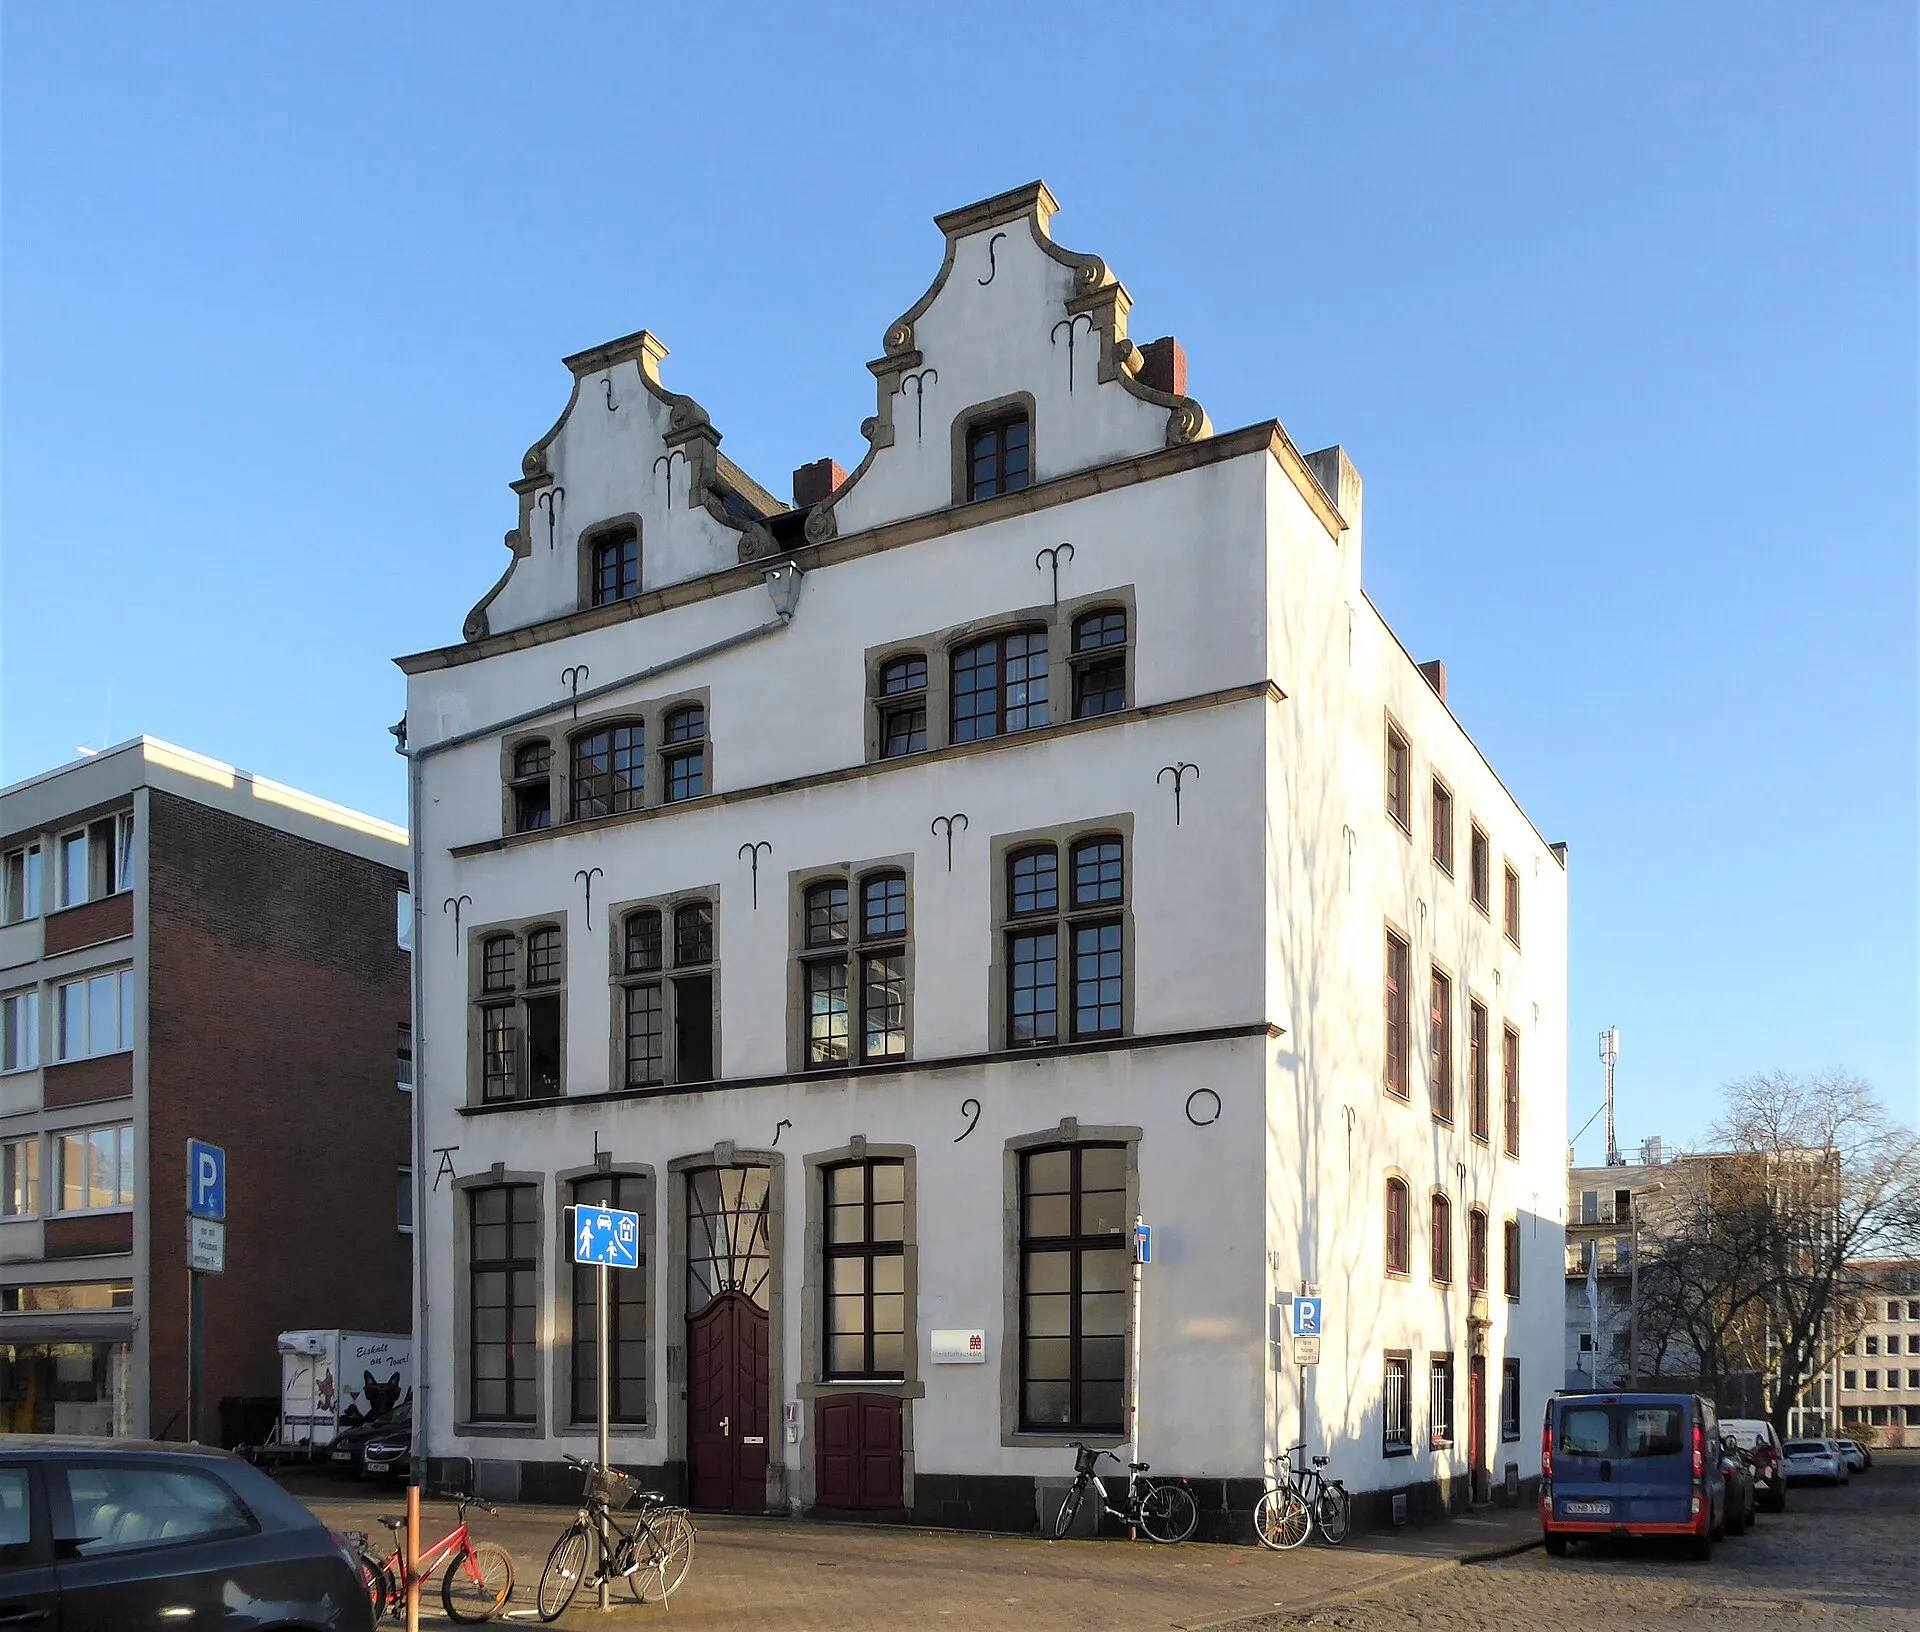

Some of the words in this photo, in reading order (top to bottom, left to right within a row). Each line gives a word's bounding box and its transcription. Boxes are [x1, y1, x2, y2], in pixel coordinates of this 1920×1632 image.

[199, 1152, 217, 1205] P
[1299, 1301, 1315, 1330] P
[356, 1343, 388, 1358] Eiskalt
[370, 1357, 382, 1366] on
[386, 1352, 410, 1367] Tour!
